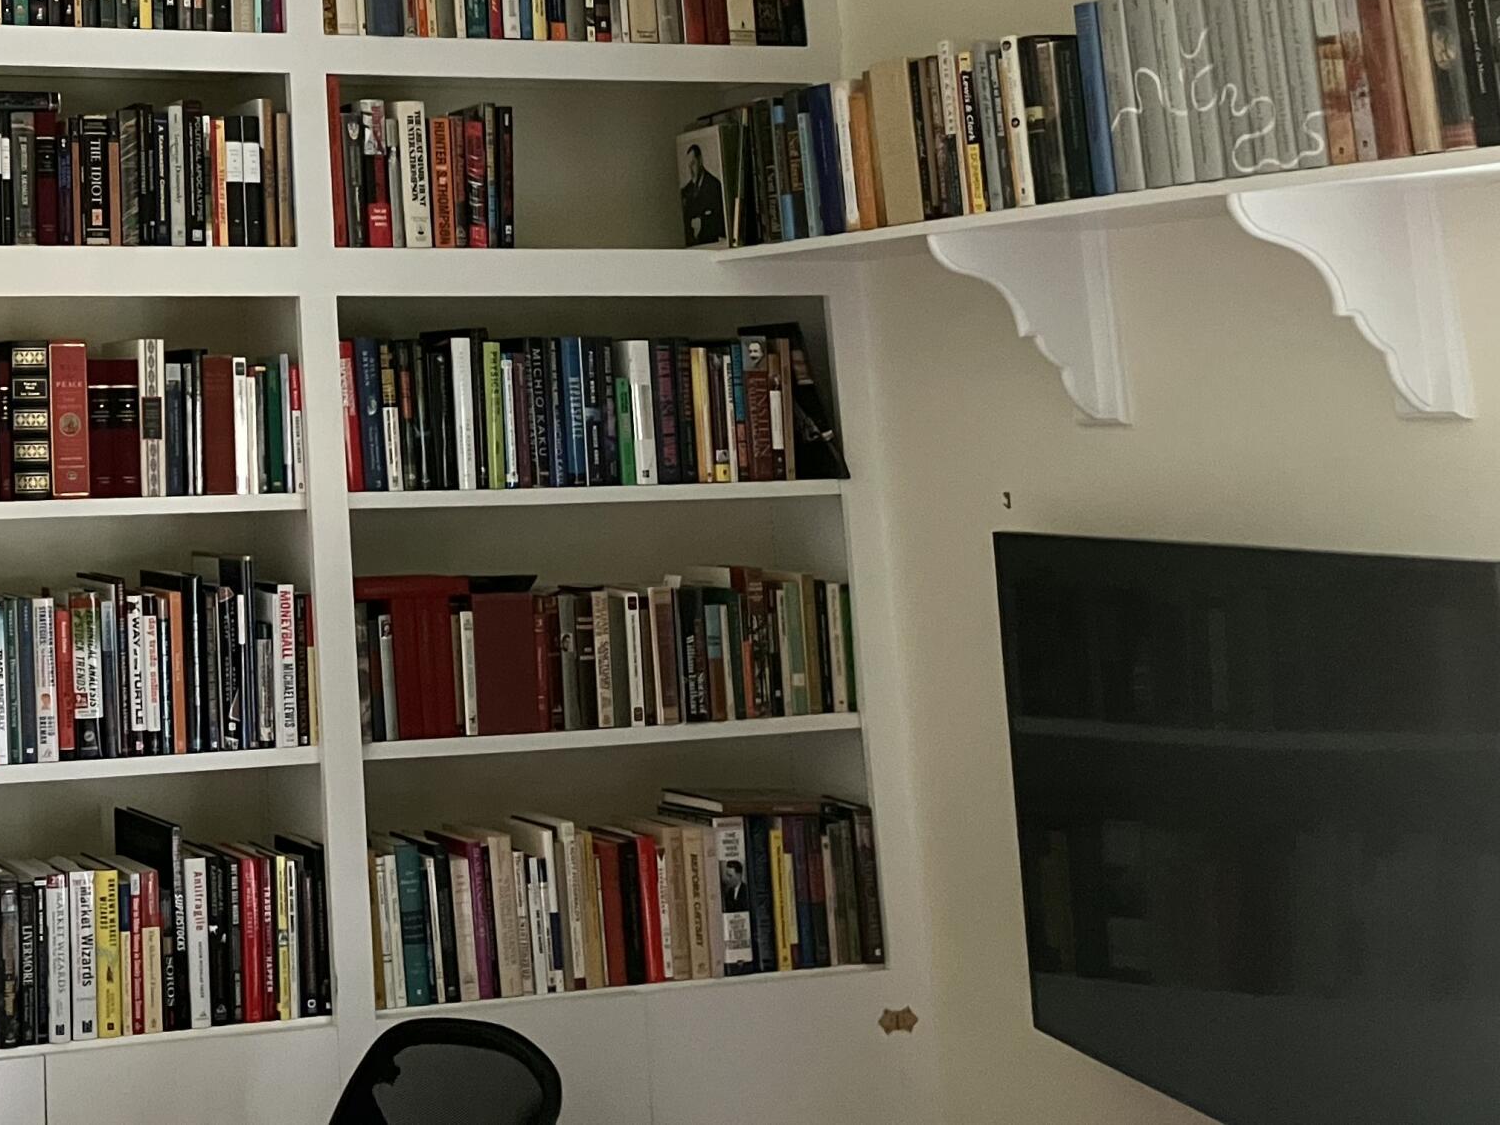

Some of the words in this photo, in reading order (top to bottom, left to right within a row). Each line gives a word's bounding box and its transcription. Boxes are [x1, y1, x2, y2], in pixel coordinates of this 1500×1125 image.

[962, 75, 972, 103] Lewis
[964, 105, 973, 113] &
[194, 116, 202, 160] POLITICAL
[434, 121, 446, 165] HUNTER
[965, 114, 976, 141] Clark
[89, 138, 102, 162] THE
[90, 166, 103, 204] IDIOT
[195, 163, 203, 221] APOCALYPSE
[435, 183, 450, 245] THOMPSON
[490, 351, 500, 394] PHYSICS
[532, 348, 544, 408] MICHIO
[569, 376, 582, 439] HYPERSPACE
[537, 414, 548, 457] KAKU
[146, 617, 156, 637] day
[279, 590, 293, 659] MONEYBALL
[148, 640, 158, 665] trade
[685, 634, 697, 674] William
[149, 668, 159, 703] online
[283, 662, 294, 702] MICHAEL
[687, 674, 700, 714] Faulkner
[283, 703, 295, 729] LEWIS
[78, 886, 95, 929] Market
[193, 870, 206, 932] Antifragile
[264, 886, 274, 923] TRADES
[175, 894, 186, 952] SUPERSTOCKS
[22, 925, 34, 986] LIVERMORE
[81, 934, 95, 988] Wizards
[163, 955, 175, 1008] SOROS
